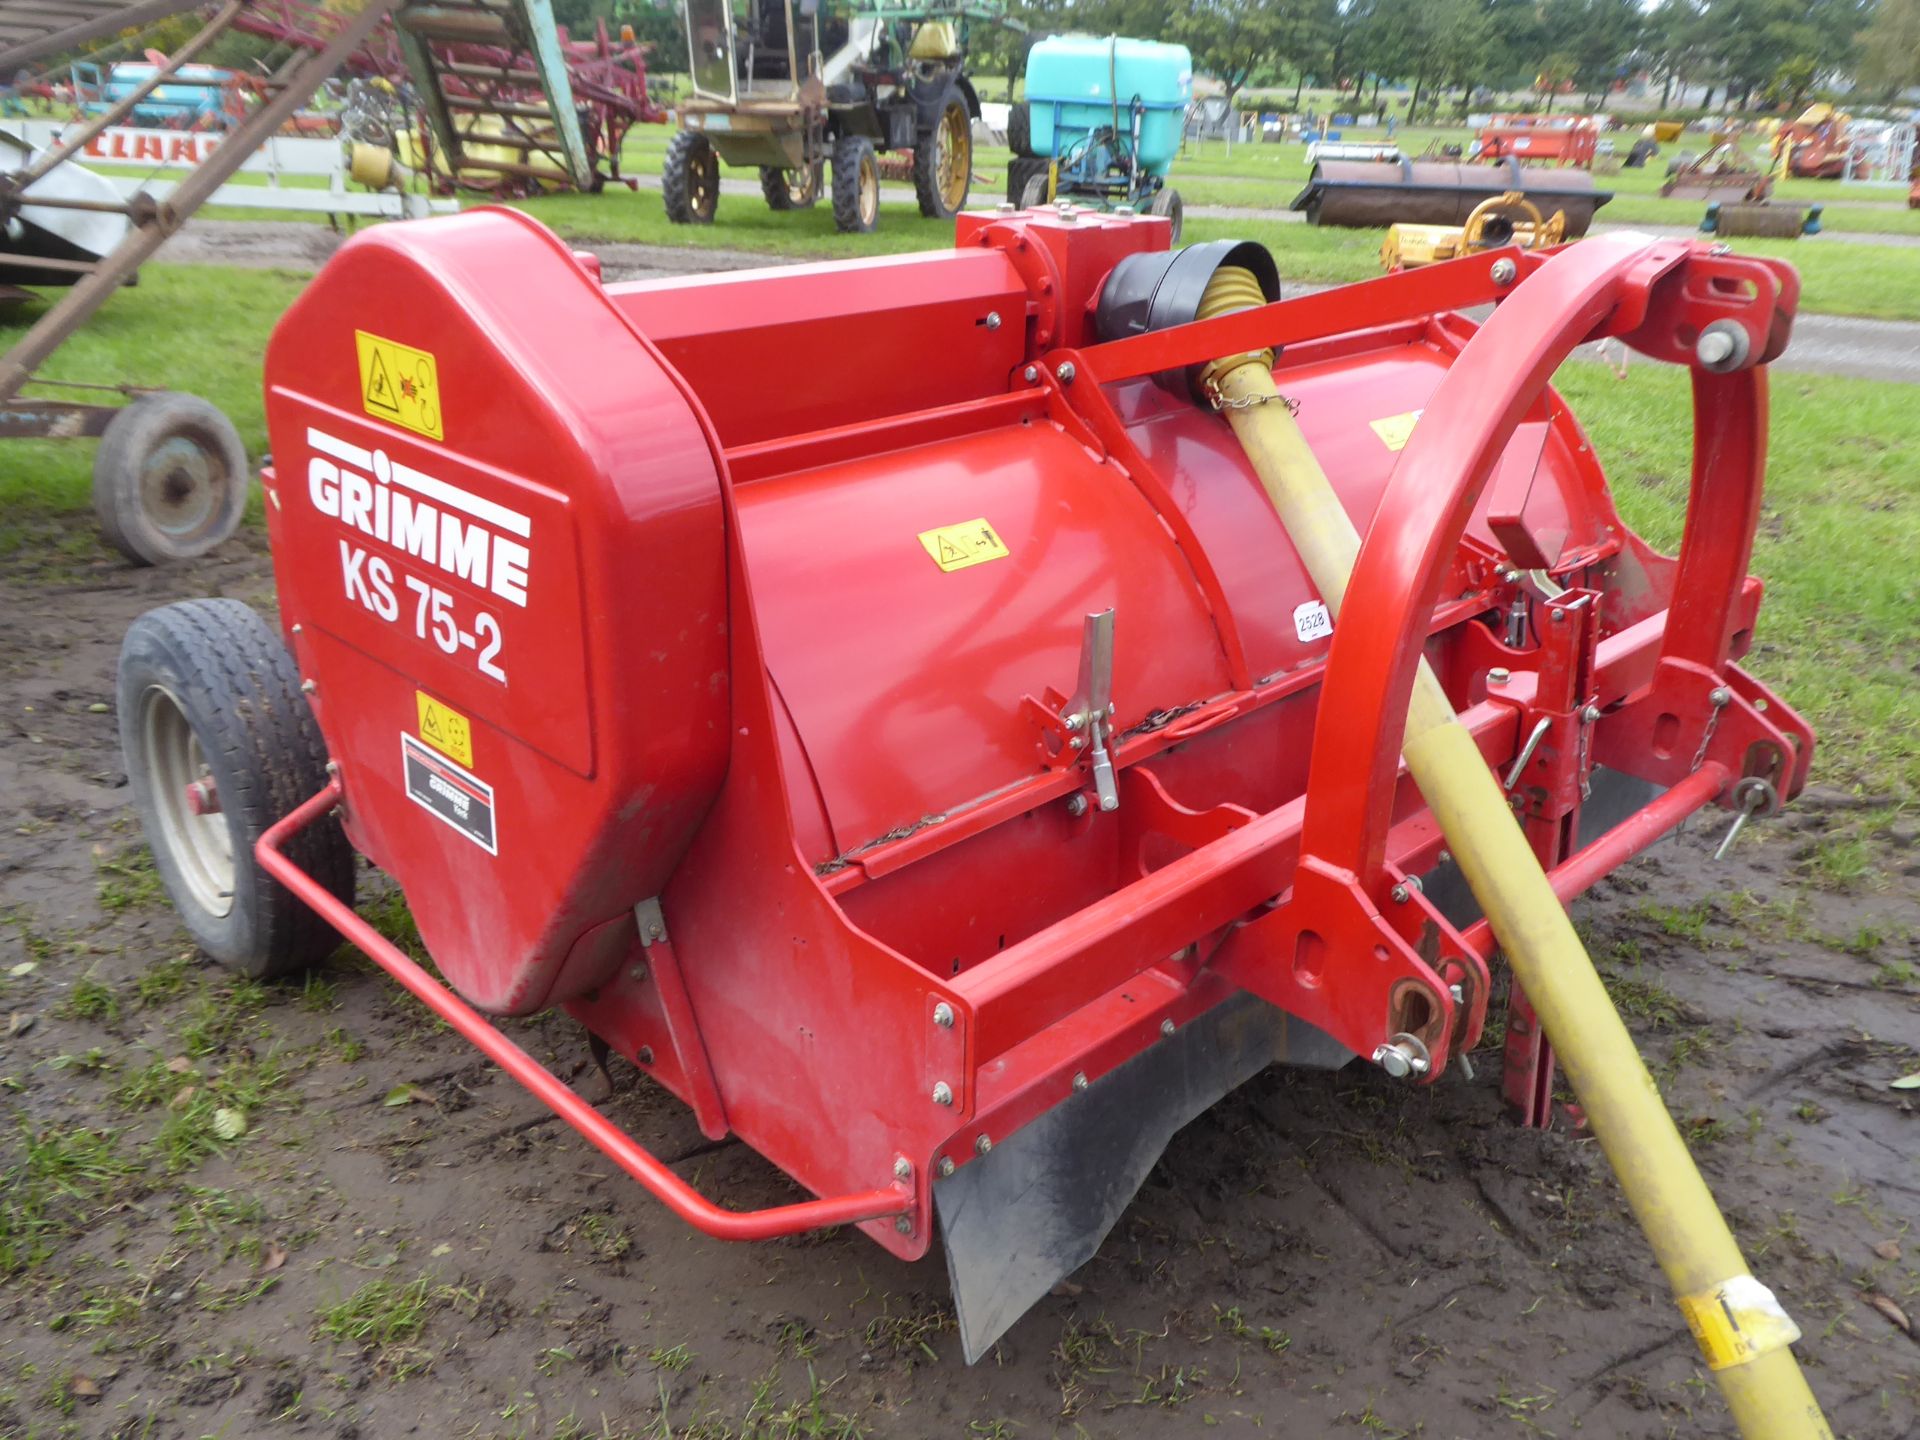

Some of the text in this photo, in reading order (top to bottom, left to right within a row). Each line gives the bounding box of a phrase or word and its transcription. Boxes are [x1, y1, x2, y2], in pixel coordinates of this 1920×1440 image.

[339, 539, 506, 683] KS 75-2
[1299, 612, 1325, 632] 2528
